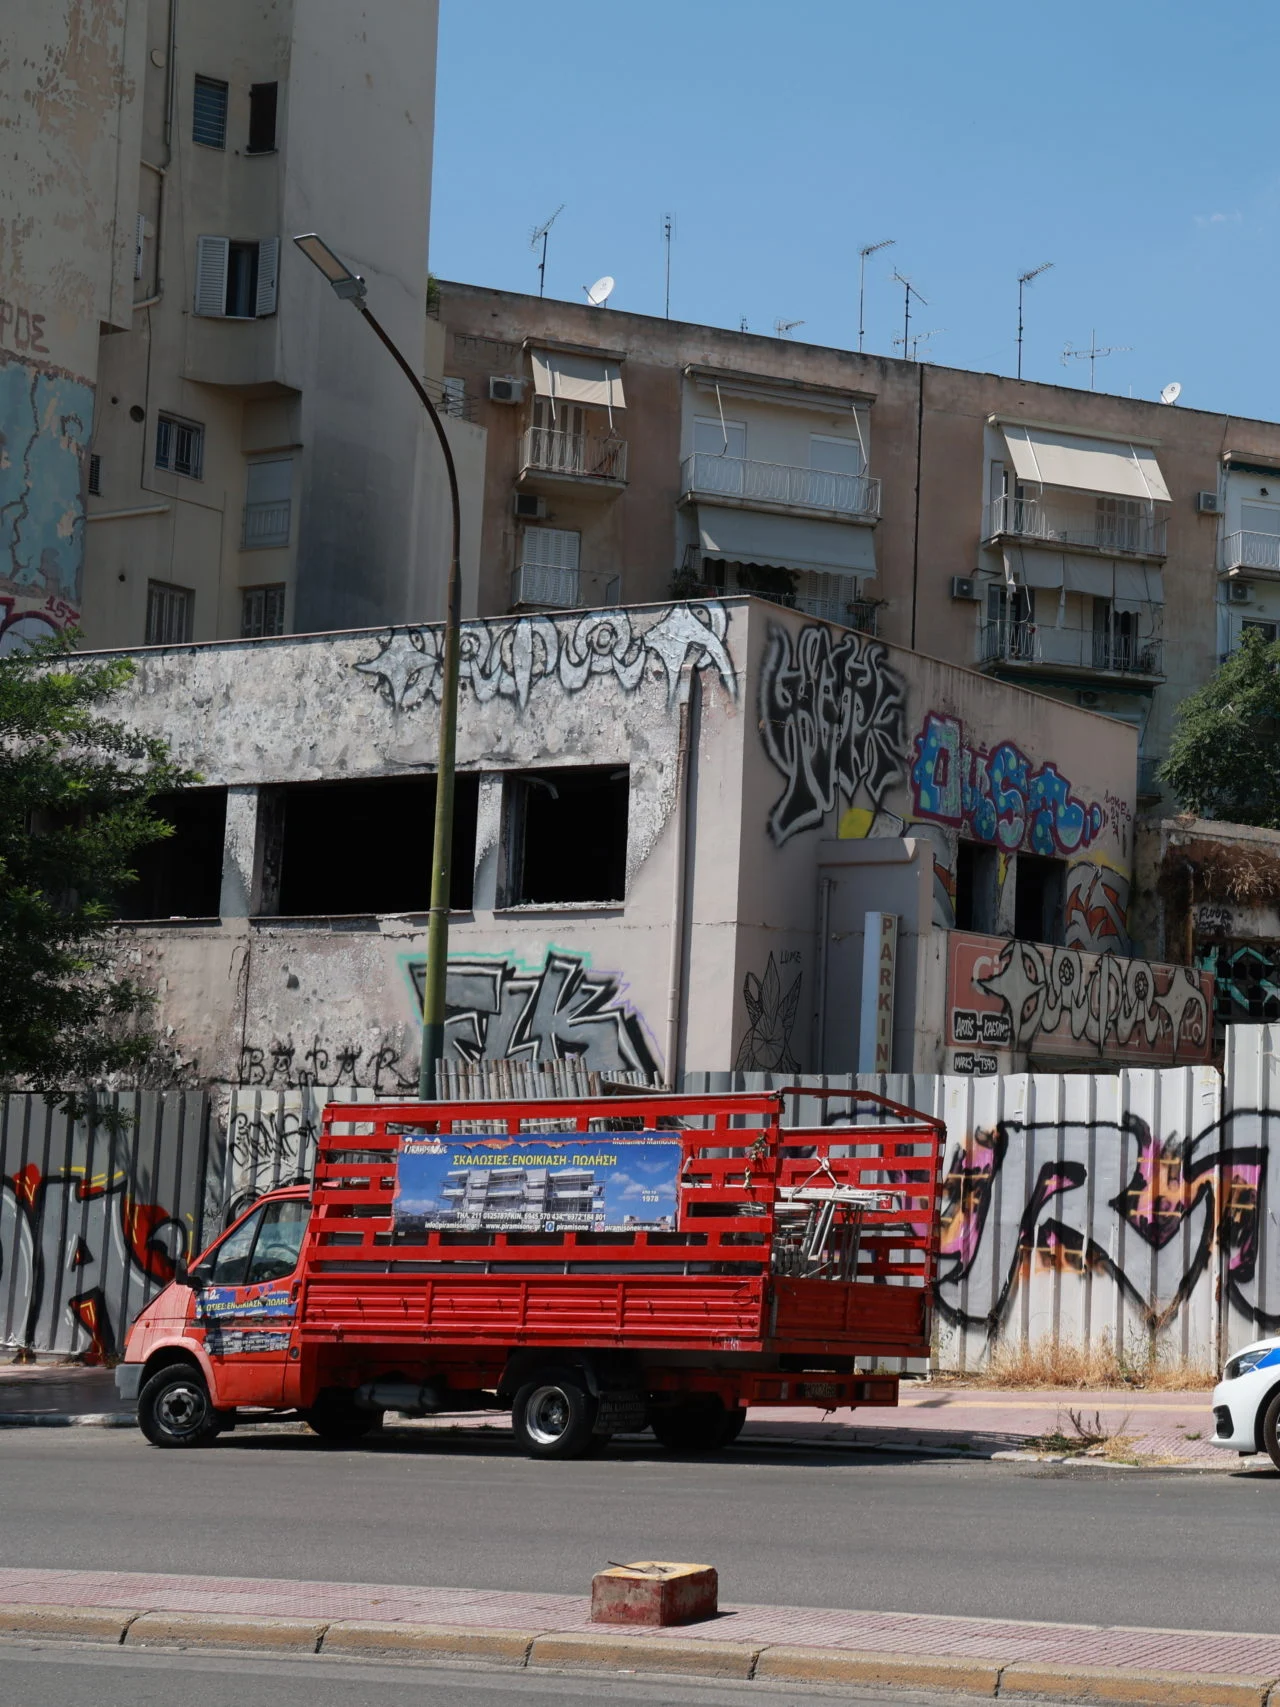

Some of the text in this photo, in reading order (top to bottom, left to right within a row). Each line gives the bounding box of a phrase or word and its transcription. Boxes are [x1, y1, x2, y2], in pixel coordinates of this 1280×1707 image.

[876, 917, 893, 1074] PARKIN
[453, 1154, 511, 1166] ΣΚΑΛΩΣΙΕΣ:
[512, 1154, 567, 1166] ΕΝΟΙΚΙΑΣΗ
[573, 1154, 618, 1166] ΠΩΛΗΣΗ
[642, 1195, 659, 1203] 1978
